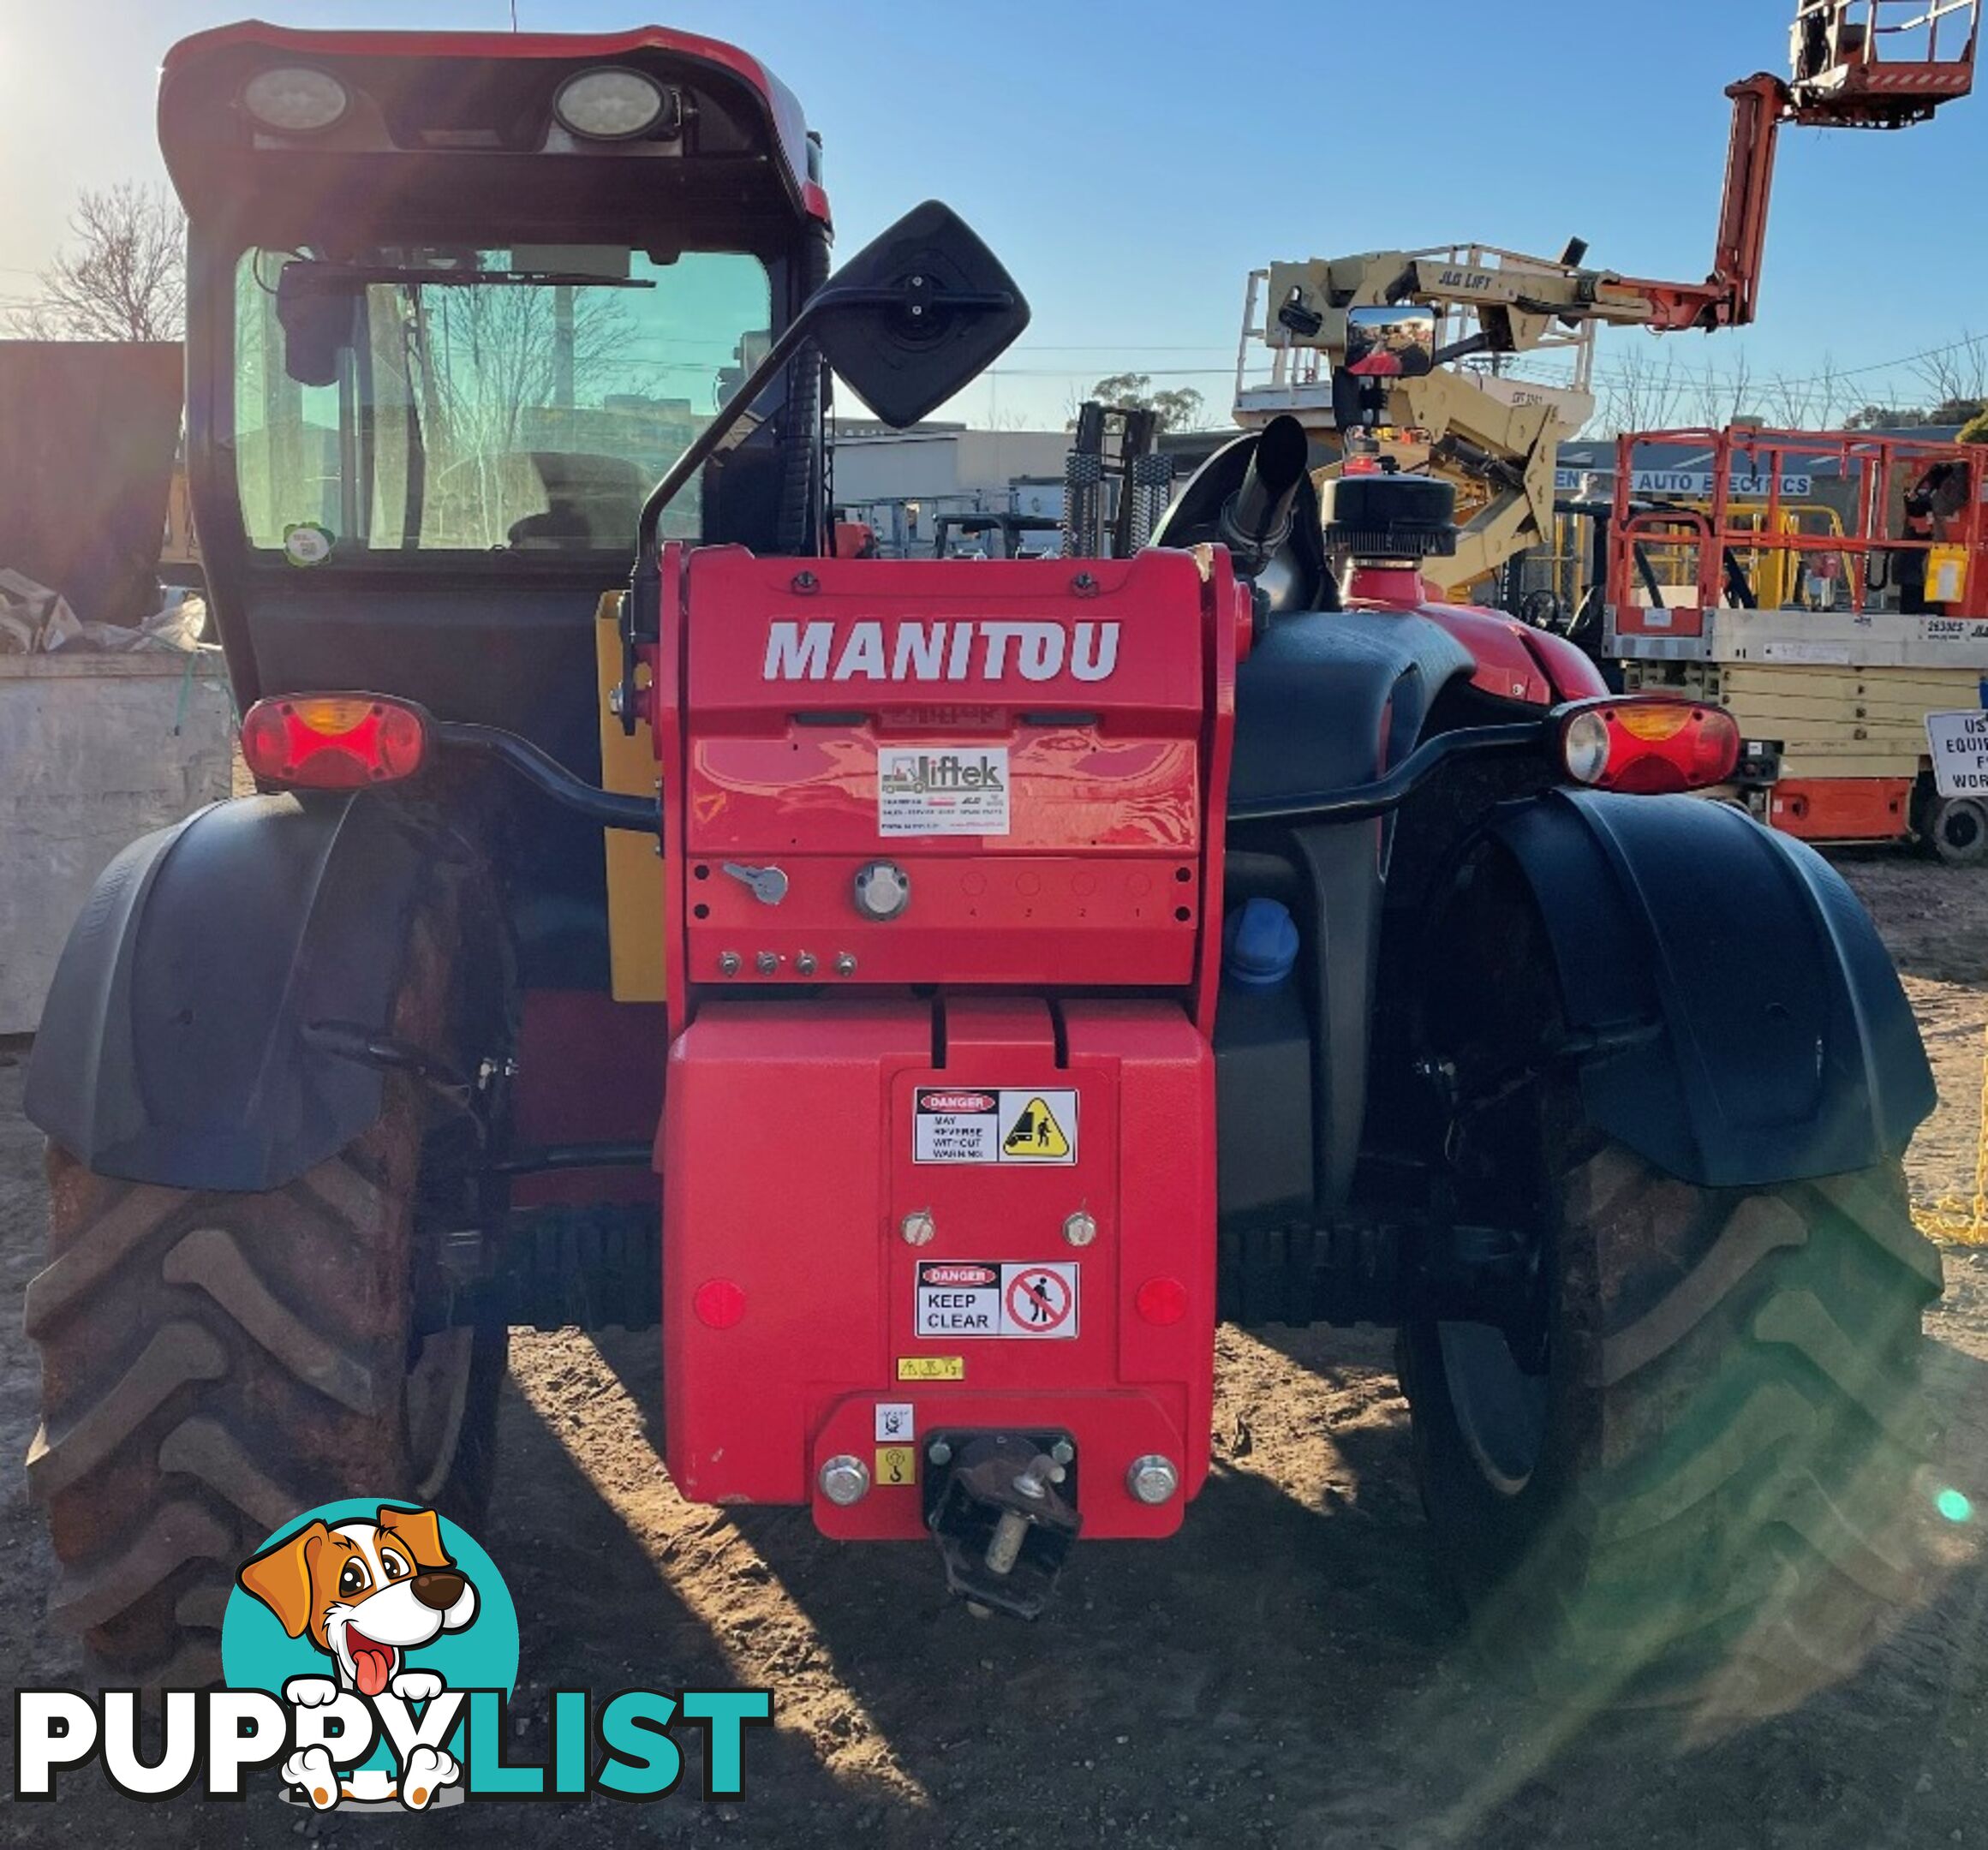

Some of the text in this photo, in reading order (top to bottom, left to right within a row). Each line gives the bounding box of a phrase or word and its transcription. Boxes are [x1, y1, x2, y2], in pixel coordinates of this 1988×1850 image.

[1639, 473, 1692, 490] AUTO
[1704, 474, 1808, 494] EECTCS
[764, 621, 1119, 681] MANITOU
[1977, 755, 1988, 769] F
[930, 1096, 984, 1107] DANGER
[934, 1116, 957, 1125] MAY
[934, 1128, 982, 1137] REVERSE
[933, 1138, 982, 1147] WITHOUT
[932, 1270, 985, 1281] DANGER
[928, 1294, 976, 1308] KEEP
[928, 1313, 988, 1328] CLEAR
